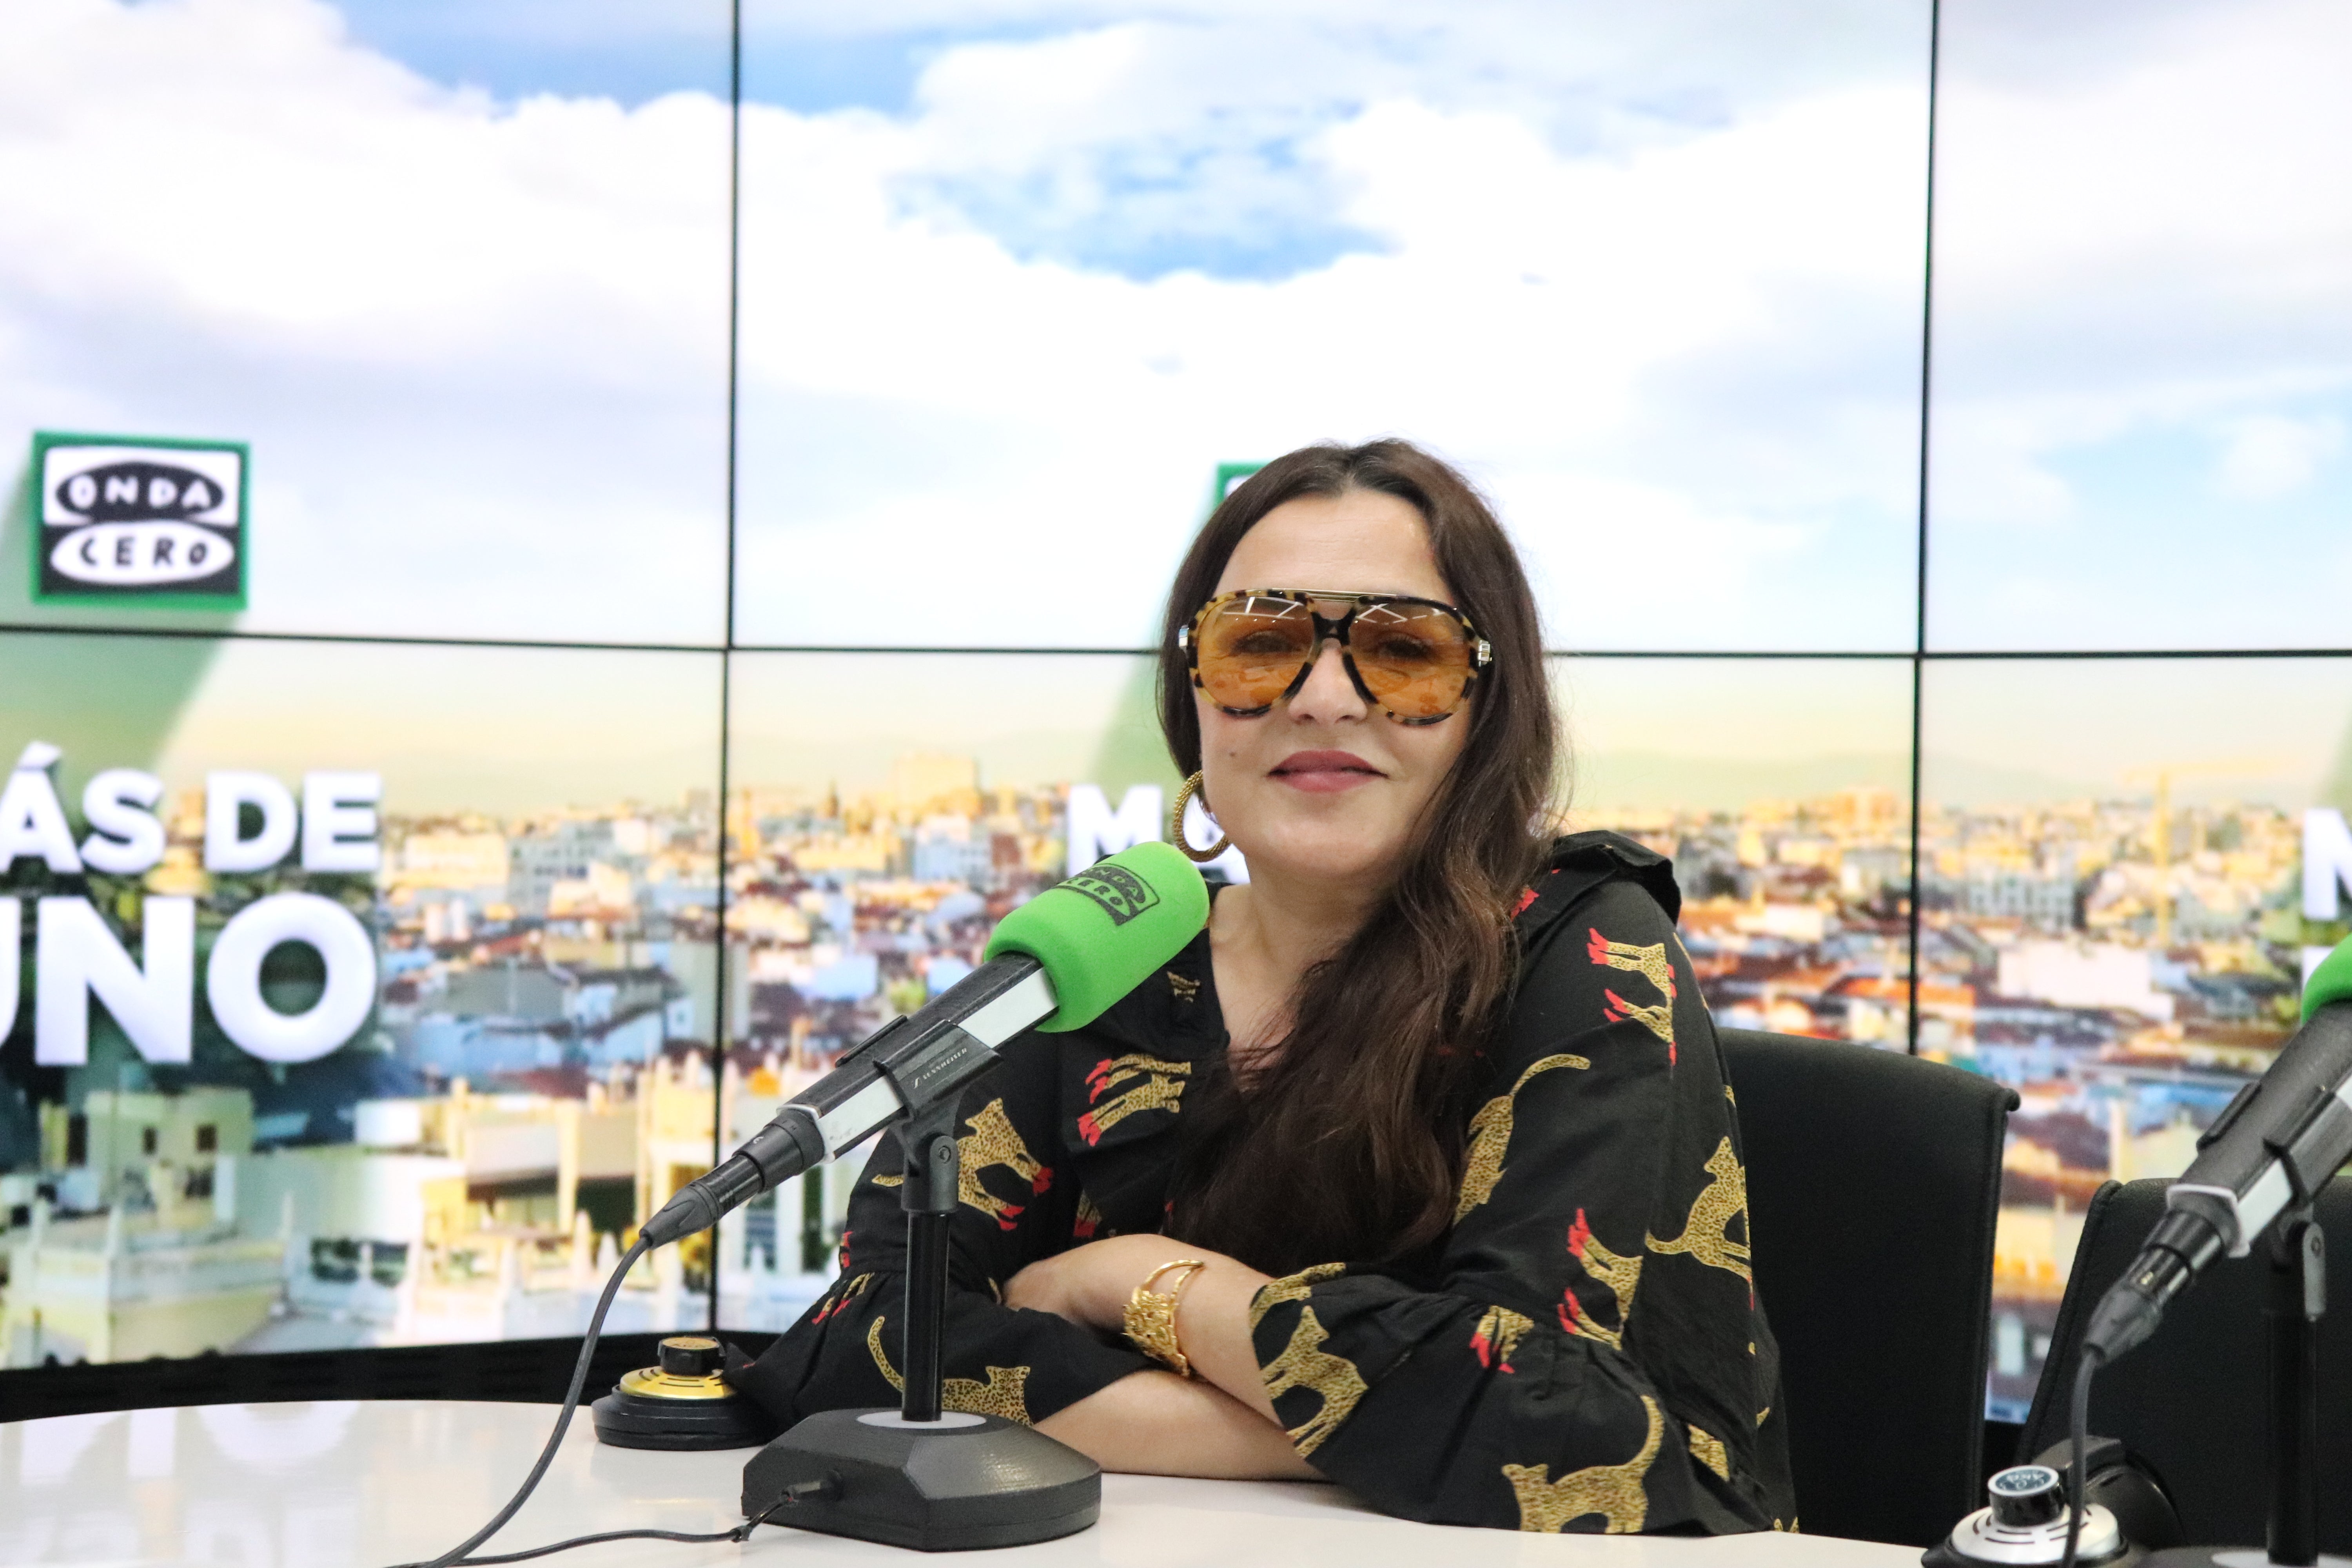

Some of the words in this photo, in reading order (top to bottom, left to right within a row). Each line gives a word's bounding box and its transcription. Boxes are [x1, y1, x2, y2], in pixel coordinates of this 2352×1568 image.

[68, 474, 212, 510] ONDA
[80, 535, 209, 567] CERO
[205, 771, 381, 873] DE
[0, 893, 376, 1065] NO
